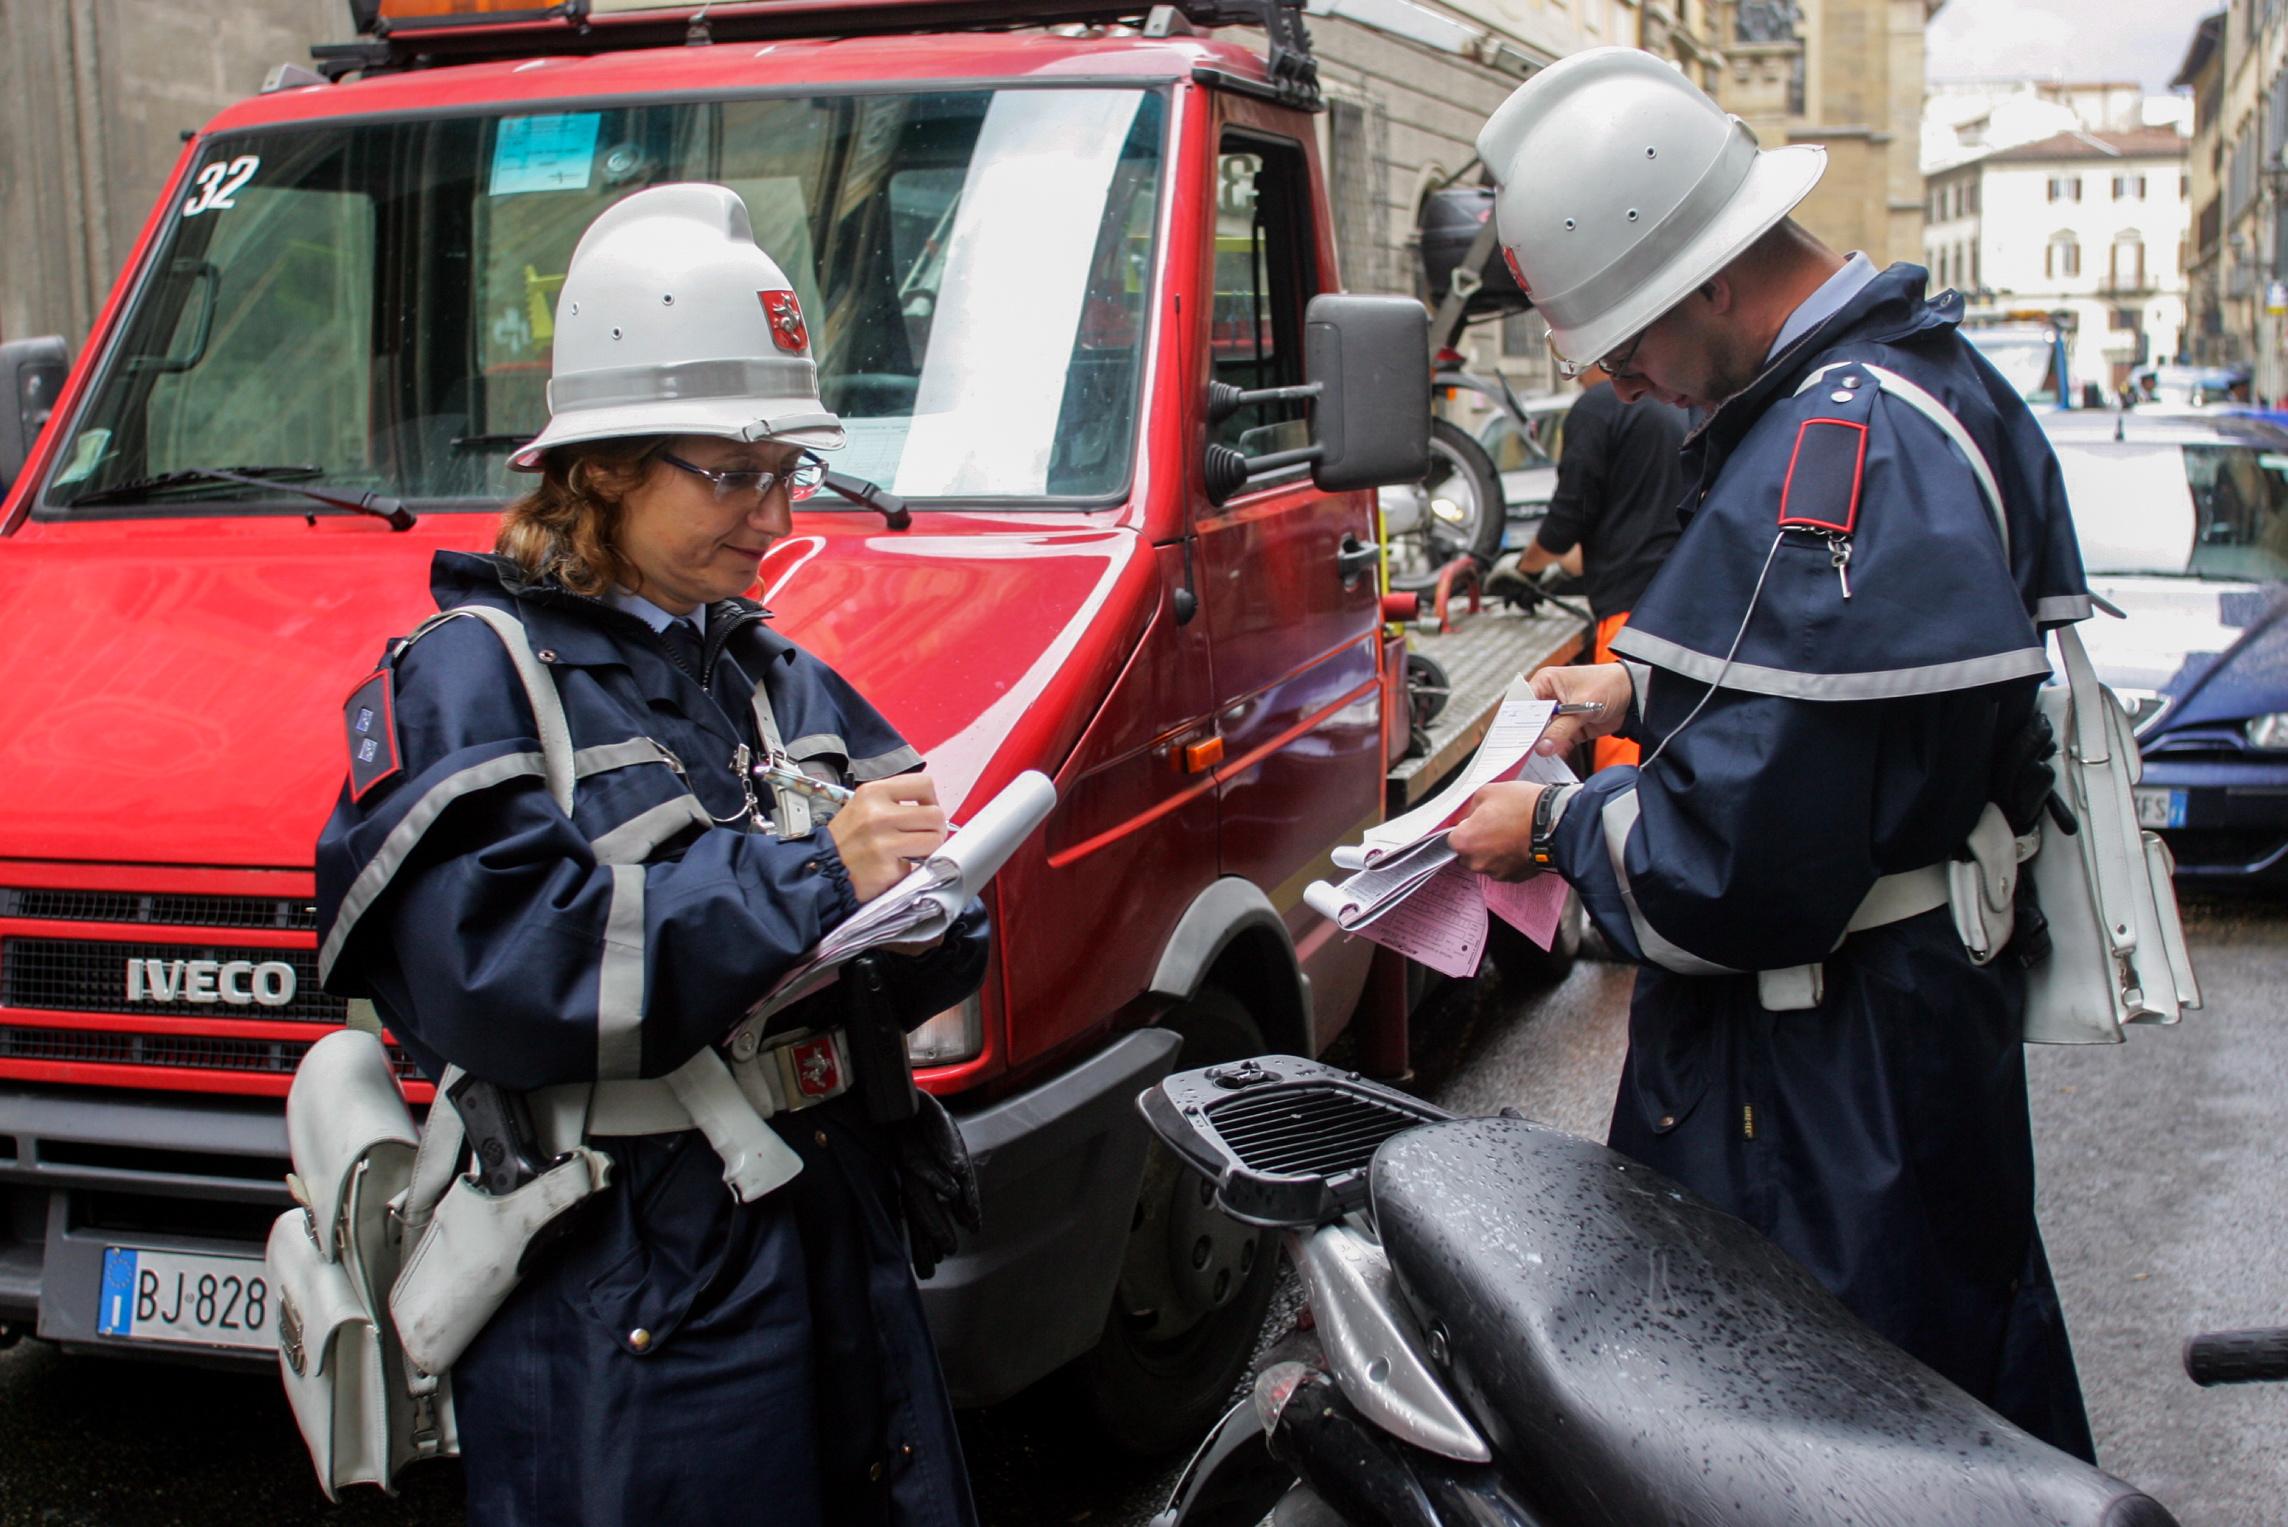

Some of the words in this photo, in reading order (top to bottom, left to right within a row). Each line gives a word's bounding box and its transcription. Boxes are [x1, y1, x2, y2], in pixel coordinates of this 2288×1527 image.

[183, 155, 260, 217] 32
[127, 958, 297, 1006] IVECO
[196, 1273, 267, 1330] 828
